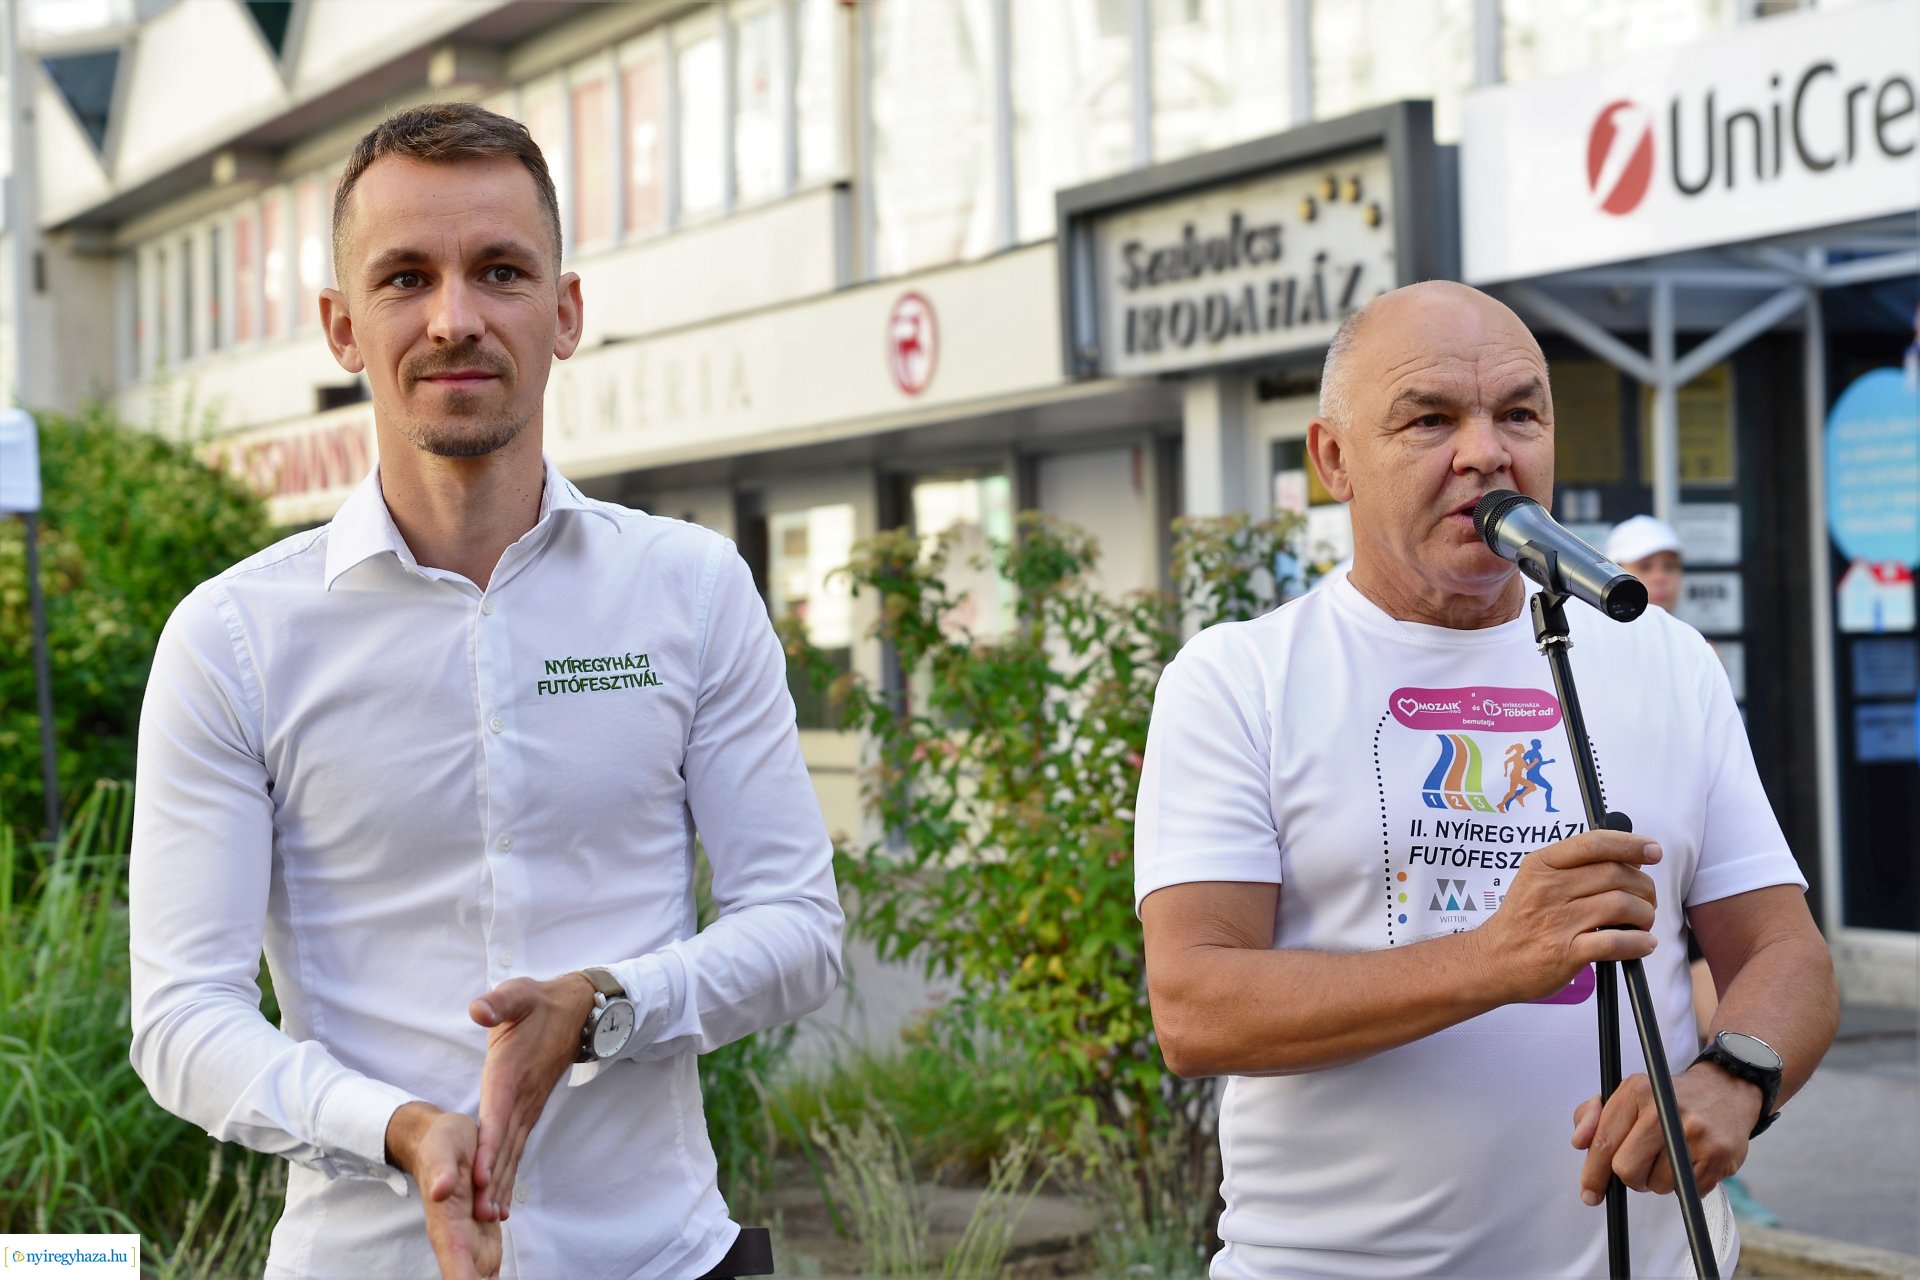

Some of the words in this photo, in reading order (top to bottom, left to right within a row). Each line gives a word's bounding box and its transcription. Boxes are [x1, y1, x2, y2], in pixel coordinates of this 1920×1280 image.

[544, 652, 650, 675] NYÍREGYHÁZI
[537, 669, 663, 696] FUTÓFESZTIVÁL
[1418, 702, 1460, 711] MOZAIK
[1503, 708, 1537, 717] Többet
[1538, 707, 1554, 716] ad!
[1462, 718, 1495, 727] bemutatja
[1450, 795, 1464, 807] 2
[1473, 796, 1486, 809] 3
[1410, 819, 1428, 837] II.
[1435, 818, 1585, 844] NYÍREGYHÁZI
[1493, 877, 1501, 887] a
[1439, 915, 1468, 923] WITTUR
